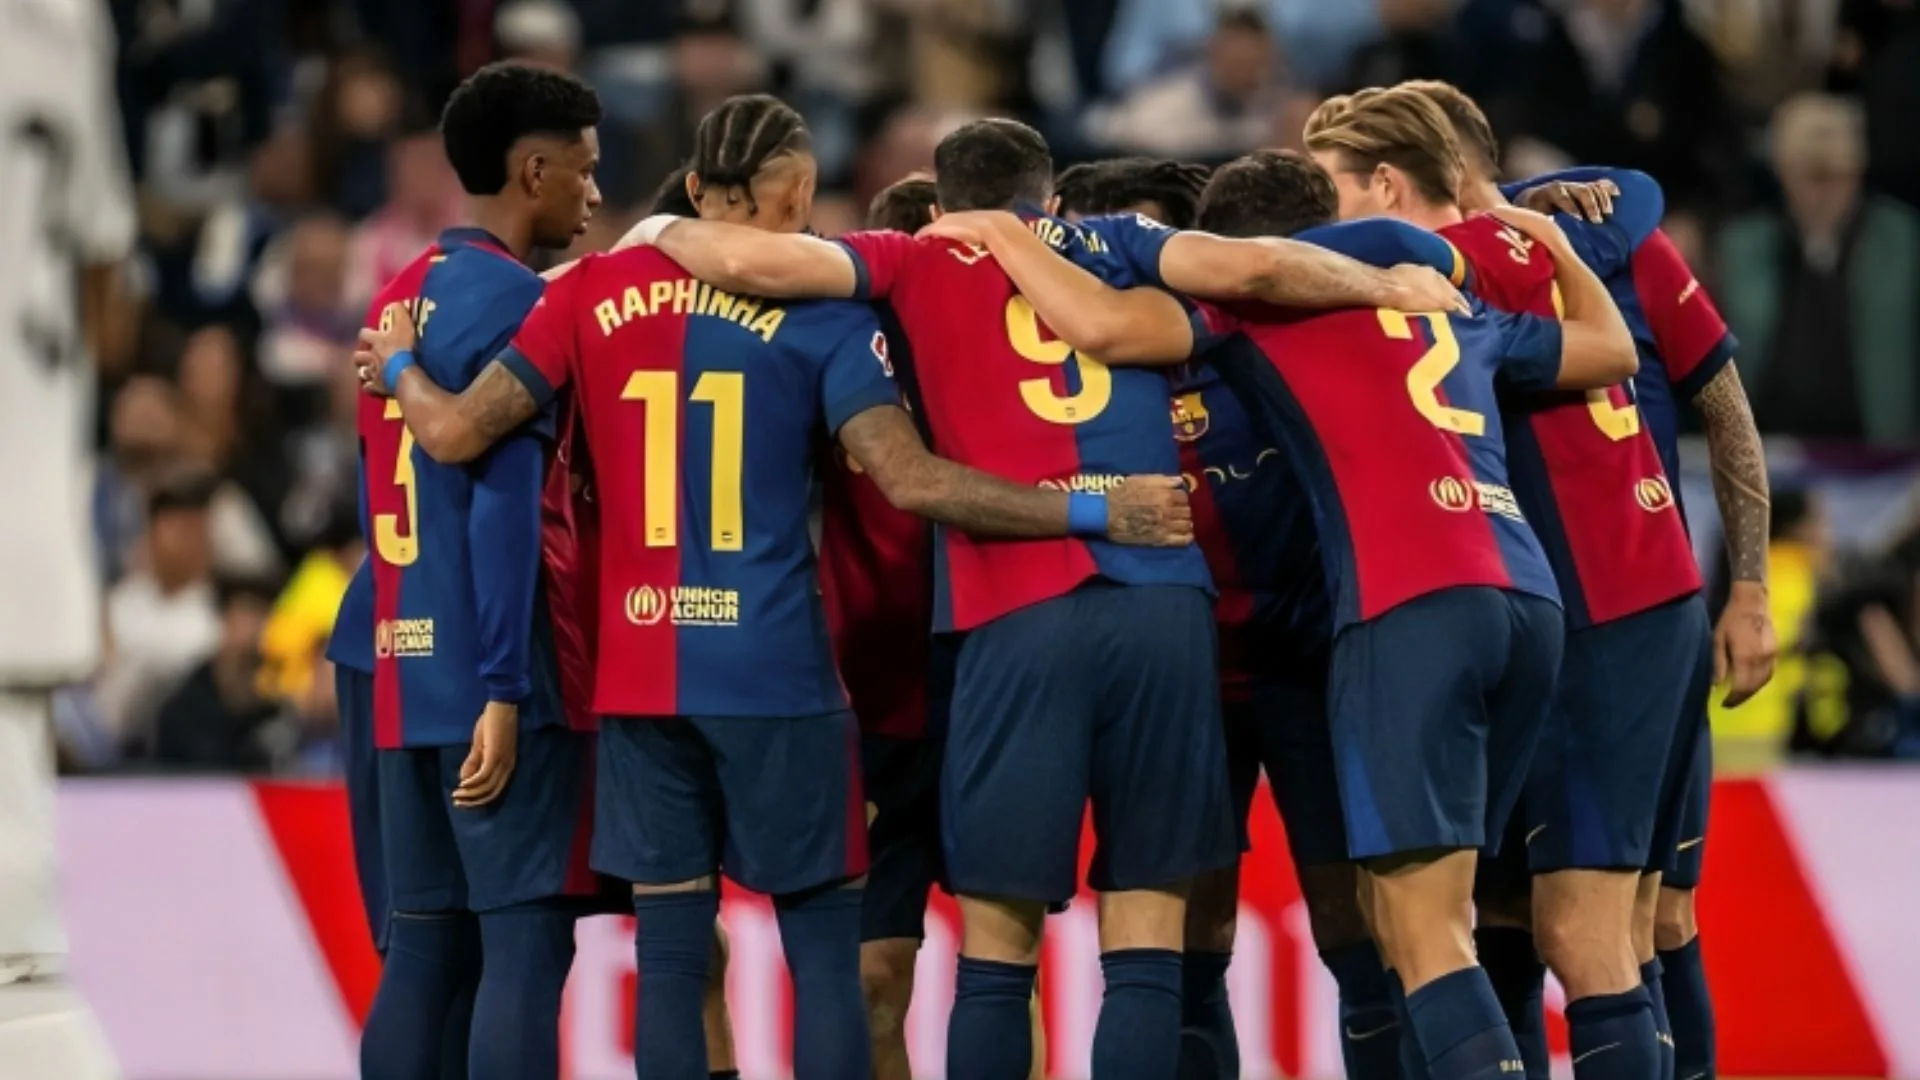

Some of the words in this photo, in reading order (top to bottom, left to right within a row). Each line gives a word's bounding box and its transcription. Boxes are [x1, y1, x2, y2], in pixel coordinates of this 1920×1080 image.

[594, 278, 786, 344] RAPHINHA
[1006, 294, 1112, 424] 9
[1377, 307, 1485, 436] 2
[374, 398, 419, 567] 3
[620, 371, 744, 551] 11
[670, 586, 738, 604] UNHCR
[670, 603, 738, 620] ACNUR
